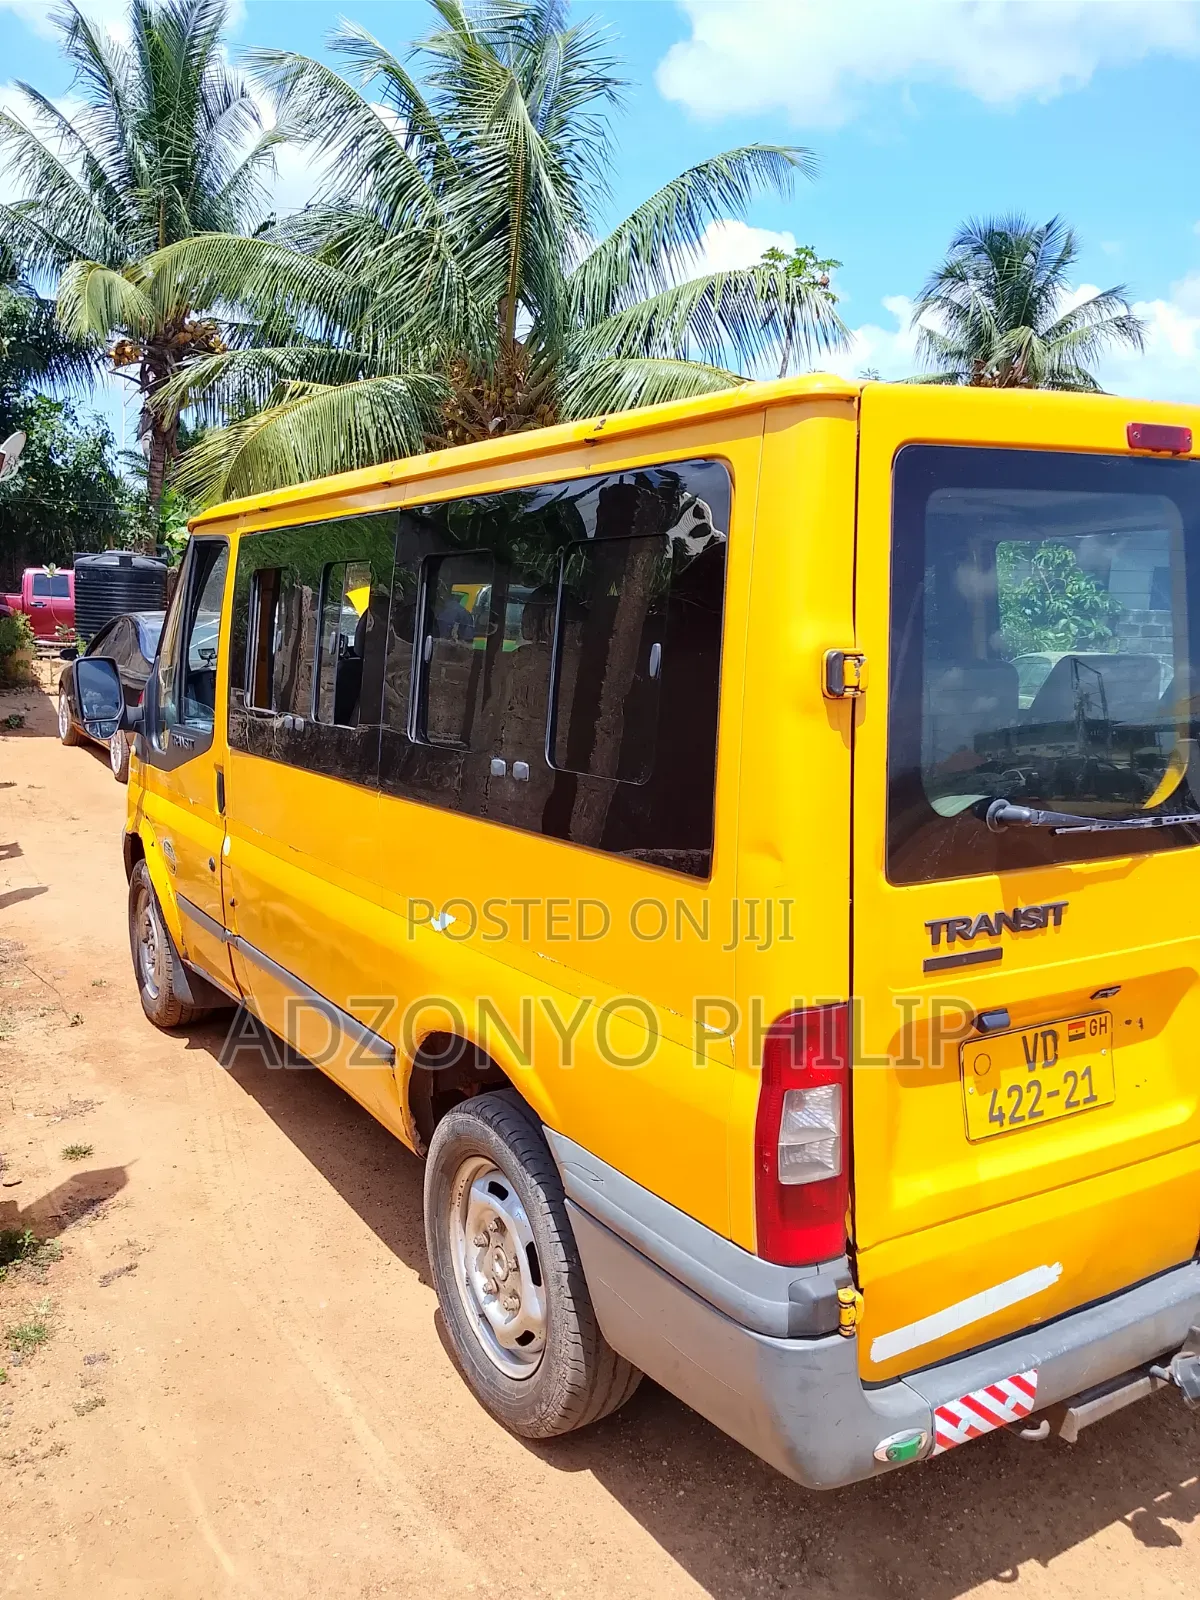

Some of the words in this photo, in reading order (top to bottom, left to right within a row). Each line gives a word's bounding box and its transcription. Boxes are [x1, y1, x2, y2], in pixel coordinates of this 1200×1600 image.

[924, 901, 1069, 945] TRANSIT
[1089, 1016, 1108, 1037] GH
[1022, 1029, 1059, 1073] VD
[988, 1065, 1098, 1128] 422-21
